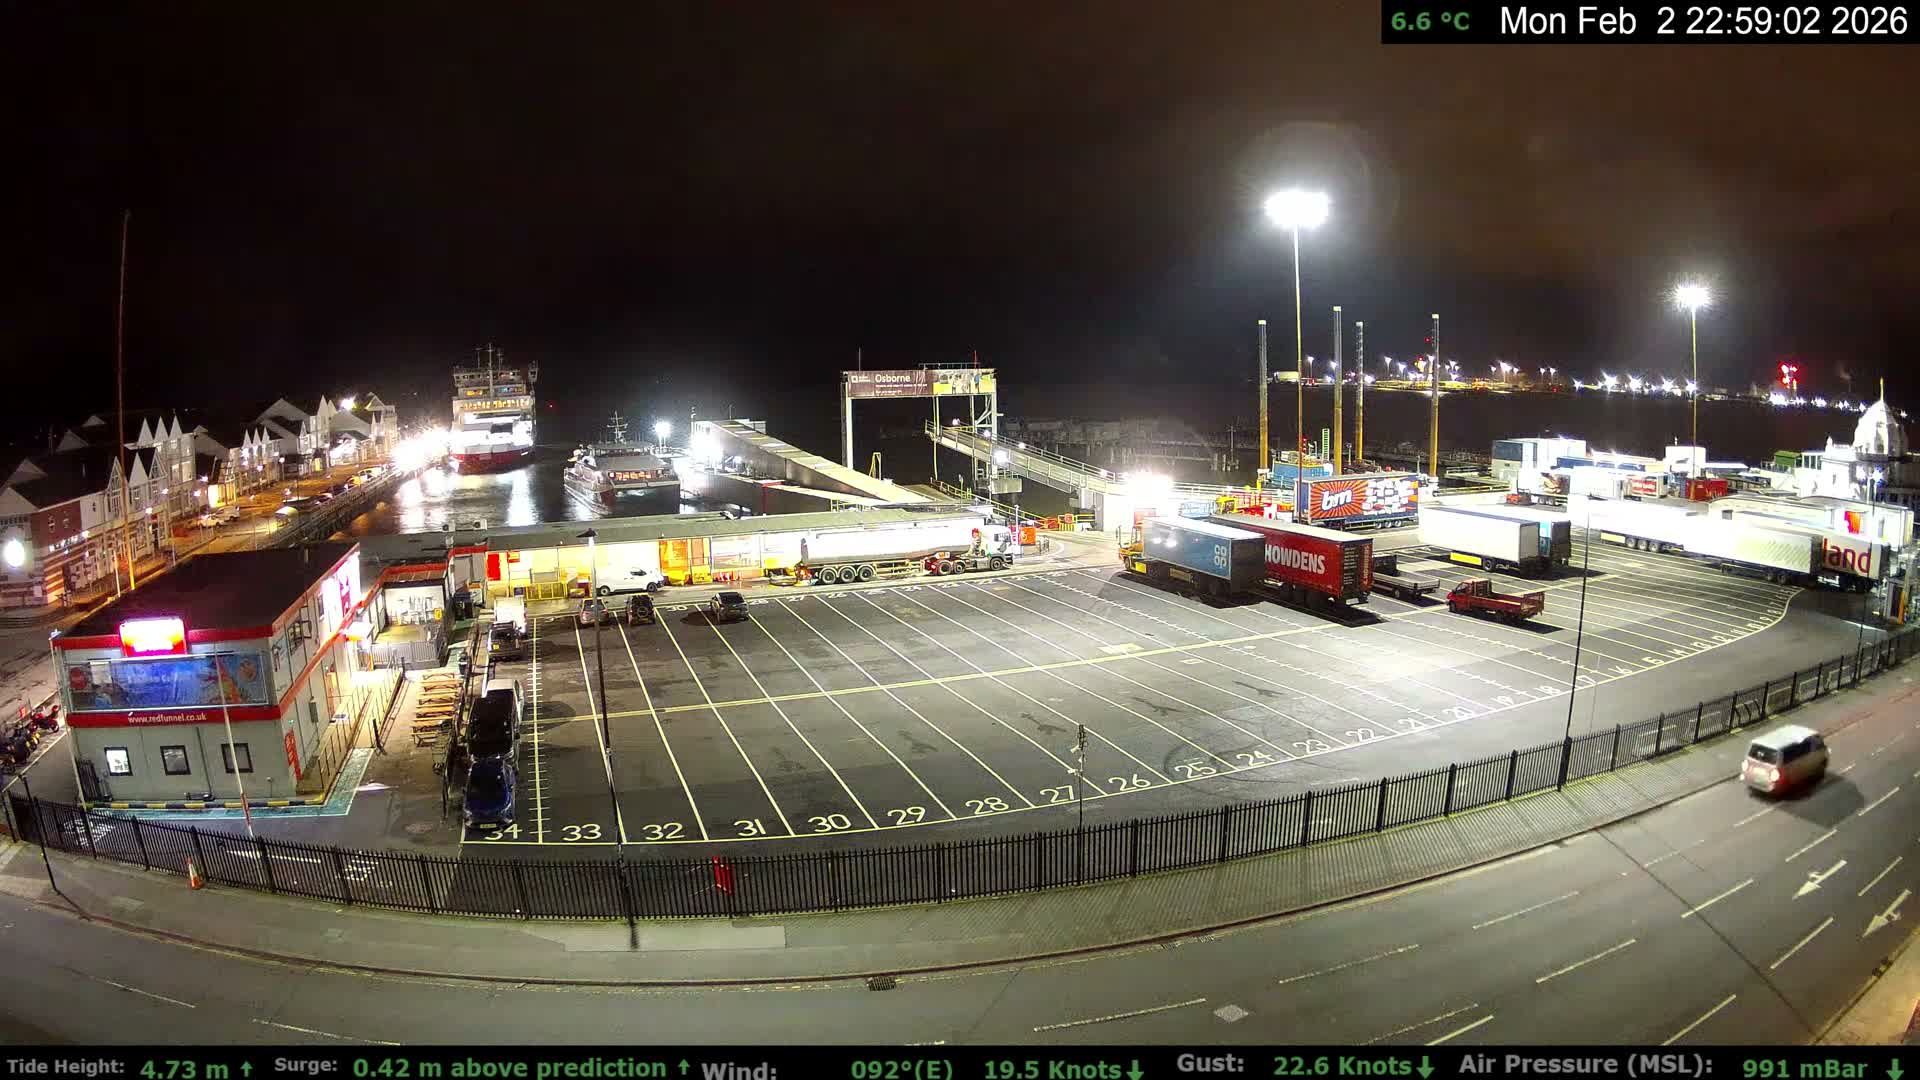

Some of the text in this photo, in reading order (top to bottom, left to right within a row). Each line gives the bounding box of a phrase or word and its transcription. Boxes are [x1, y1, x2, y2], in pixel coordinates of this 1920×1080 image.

[875, 374, 911, 383] Osborne
[1264, 543, 1326, 575] HOWDENS
[1823, 537, 1872, 574] land
[666, 604, 688, 612] 30
[127, 712, 207, 724] www.redfunnel.co.uk
[1441, 706, 1475, 719] 20
[1345, 727, 1376, 742] 22
[1293, 739, 1332, 754] 23
[1236, 750, 1276, 767] 24
[1174, 761, 1217, 779] 25
[1108, 773, 1151, 791] 26
[1039, 784, 1076, 804] 27
[965, 796, 1010, 816] 28
[807, 813, 852, 833] 30
[887, 806, 927, 826] 29
[484, 823, 523, 841] 34
[561, 823, 602, 842] 33
[641, 822, 686, 841] 32
[733, 818, 768, 837] 31
